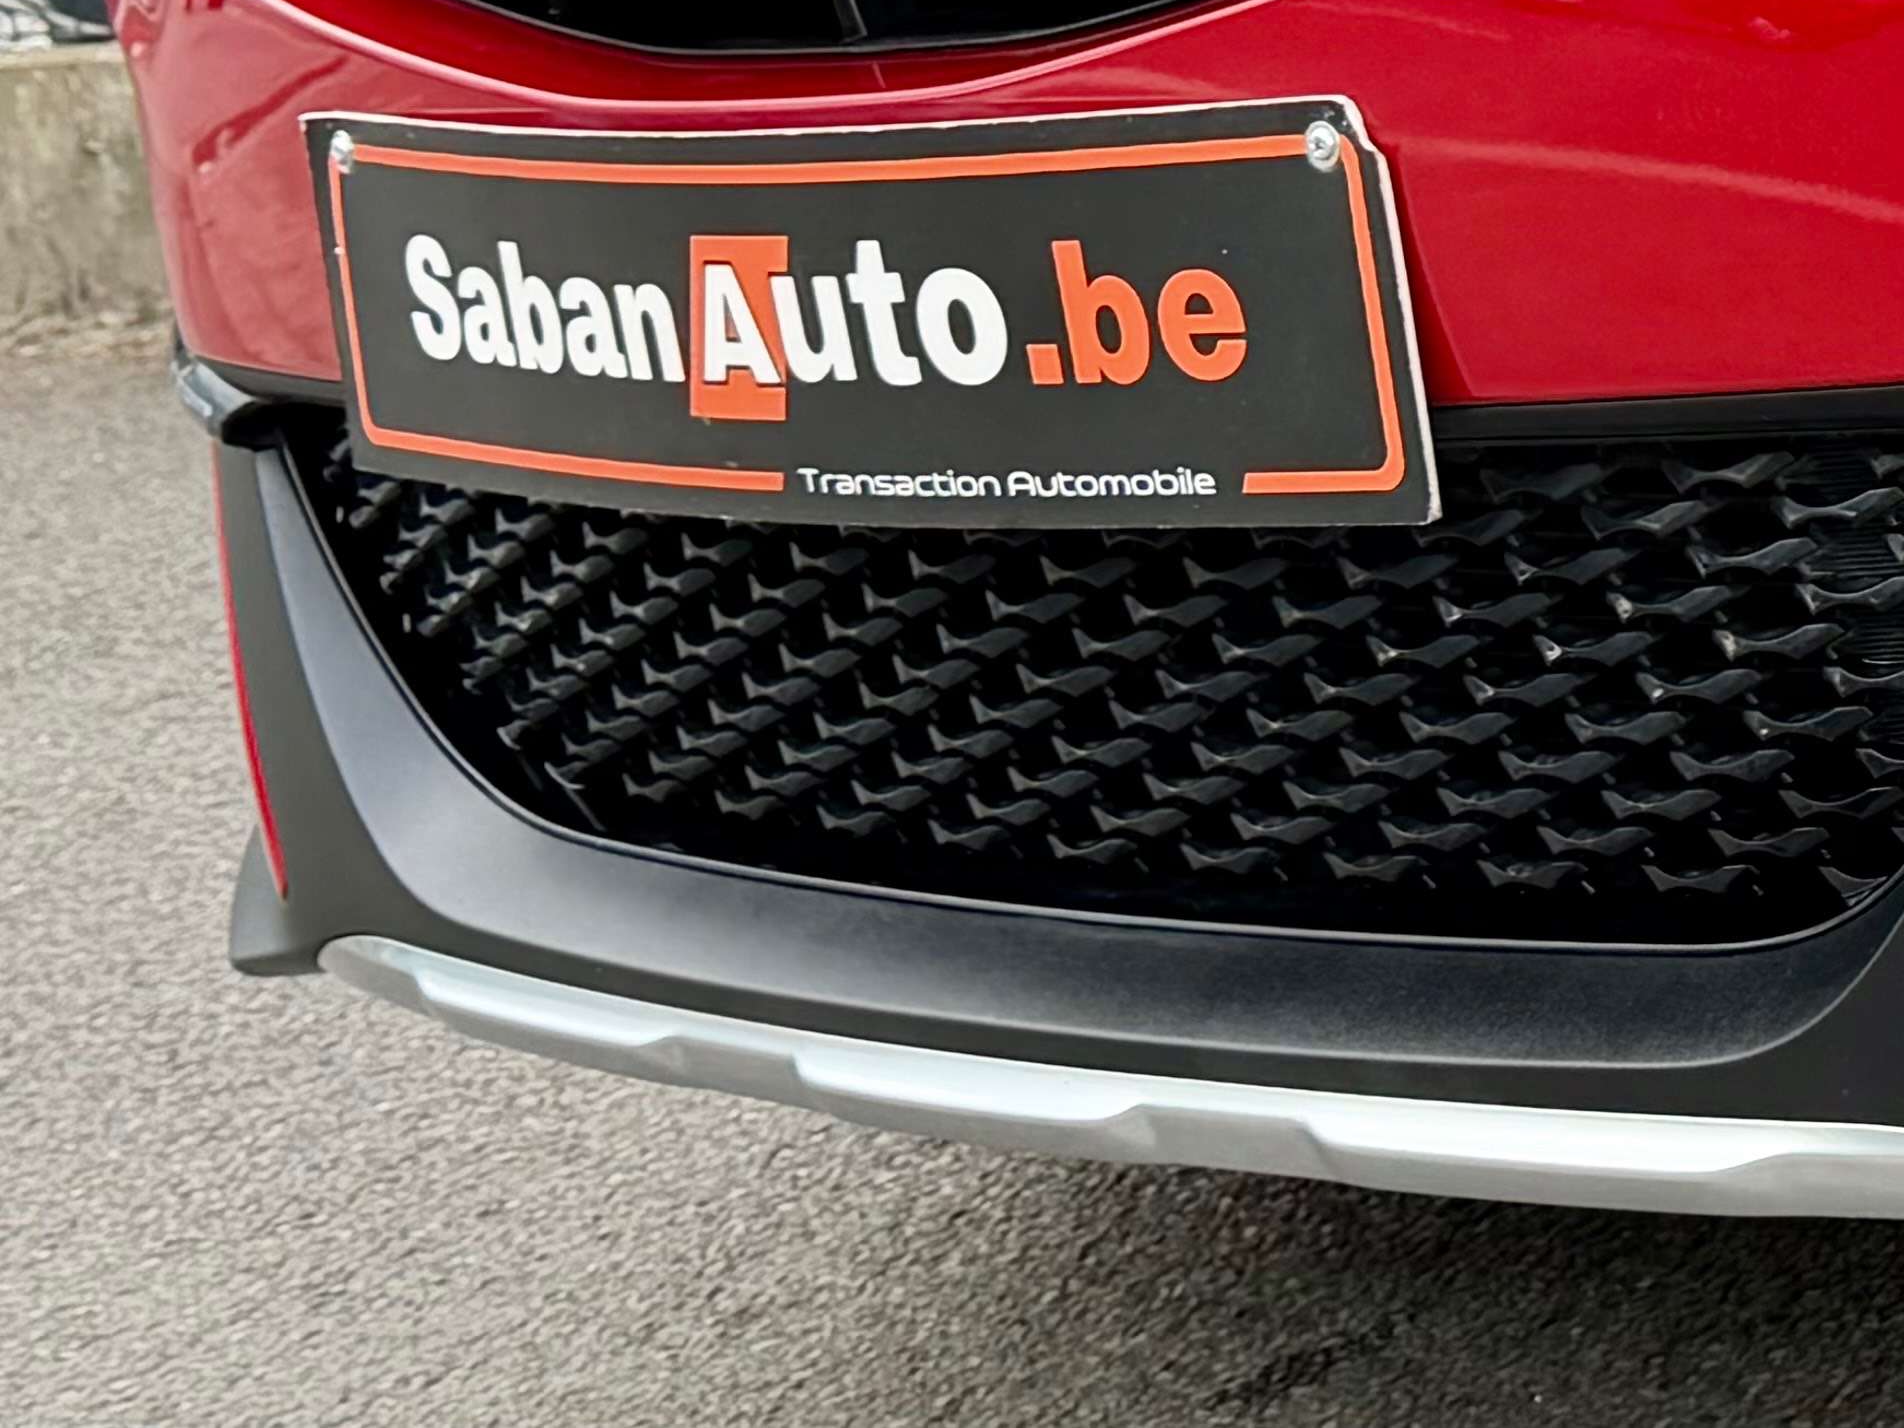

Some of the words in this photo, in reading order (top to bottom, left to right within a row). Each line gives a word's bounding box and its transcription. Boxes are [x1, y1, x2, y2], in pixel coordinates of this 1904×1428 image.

[404, 233, 1248, 388] SabanAuto.be
[797, 466, 1002, 500] Transaction
[1007, 467, 1217, 500] Automobile
